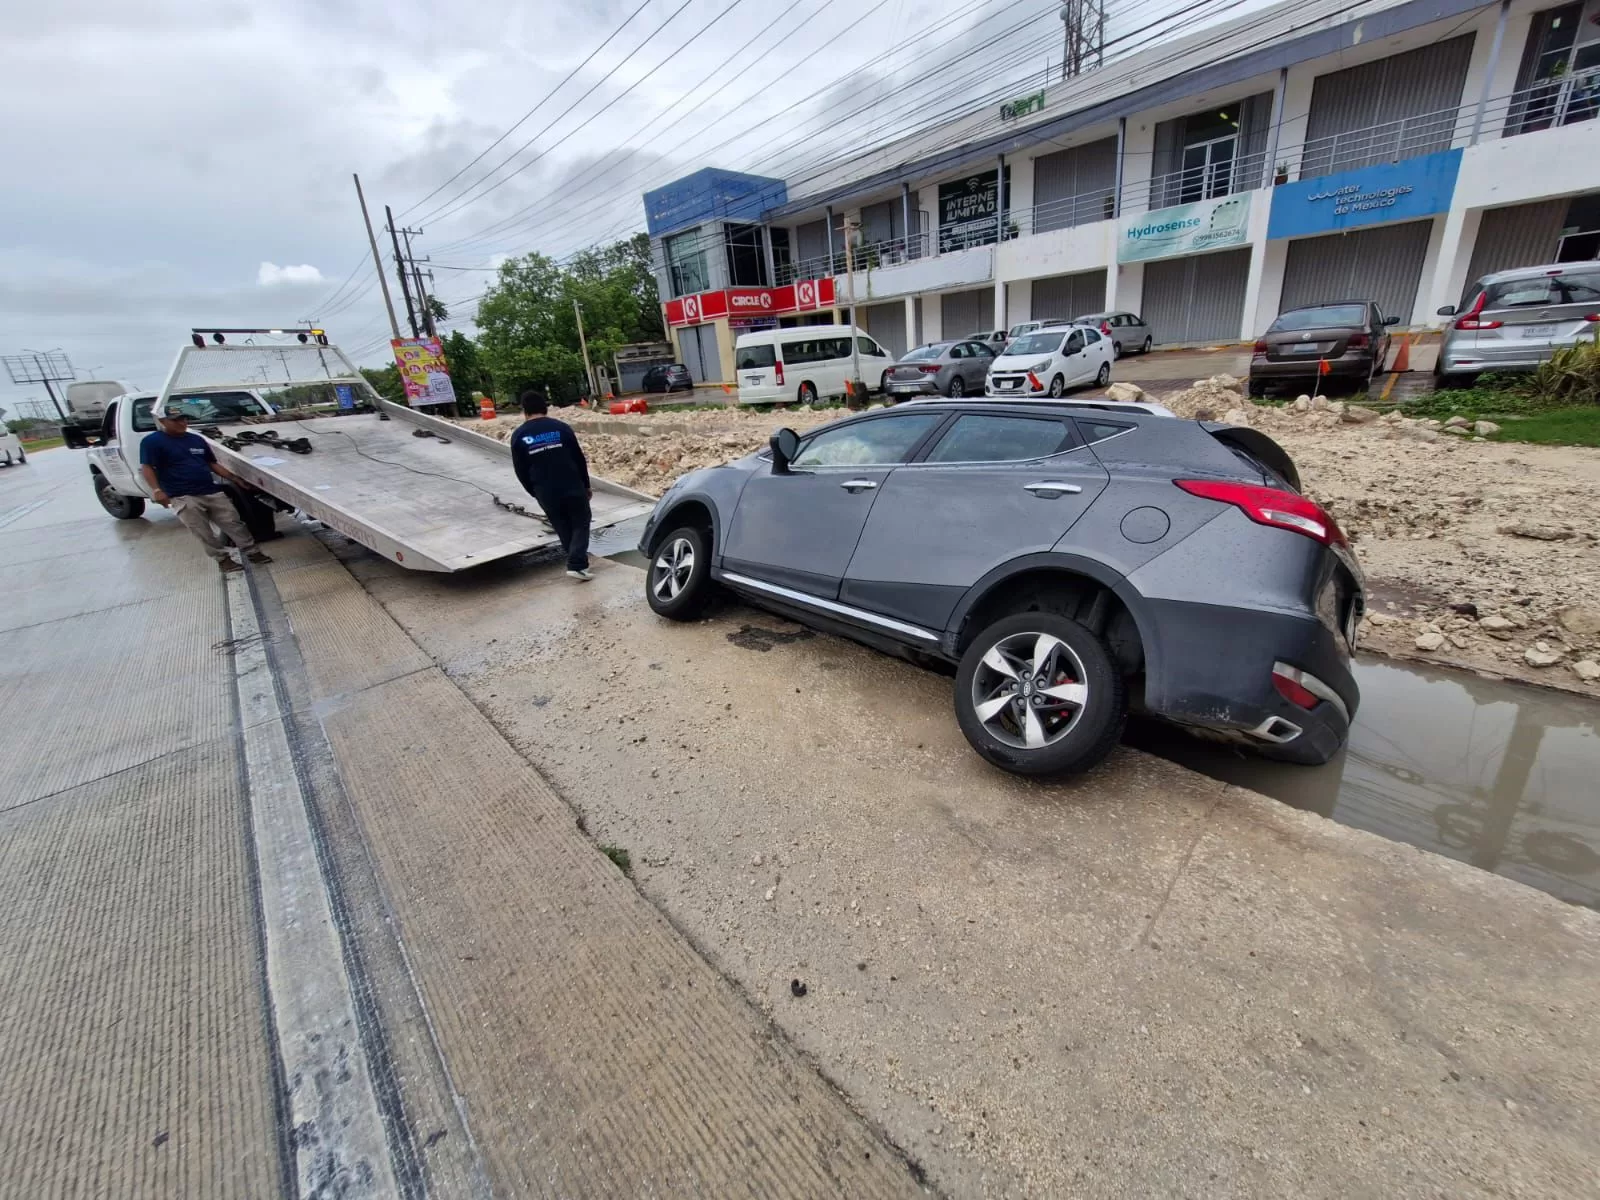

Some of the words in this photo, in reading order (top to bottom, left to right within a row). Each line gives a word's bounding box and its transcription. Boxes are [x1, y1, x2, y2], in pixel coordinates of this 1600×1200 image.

[947, 189, 997, 211] INTERNE
[1335, 184, 1413, 205] technologies
[947, 201, 999, 221] ILIMITAD
[1334, 205, 1349, 215] de
[1127, 217, 1201, 239] Hydrosense
[732, 295, 760, 306] CIRCLE
